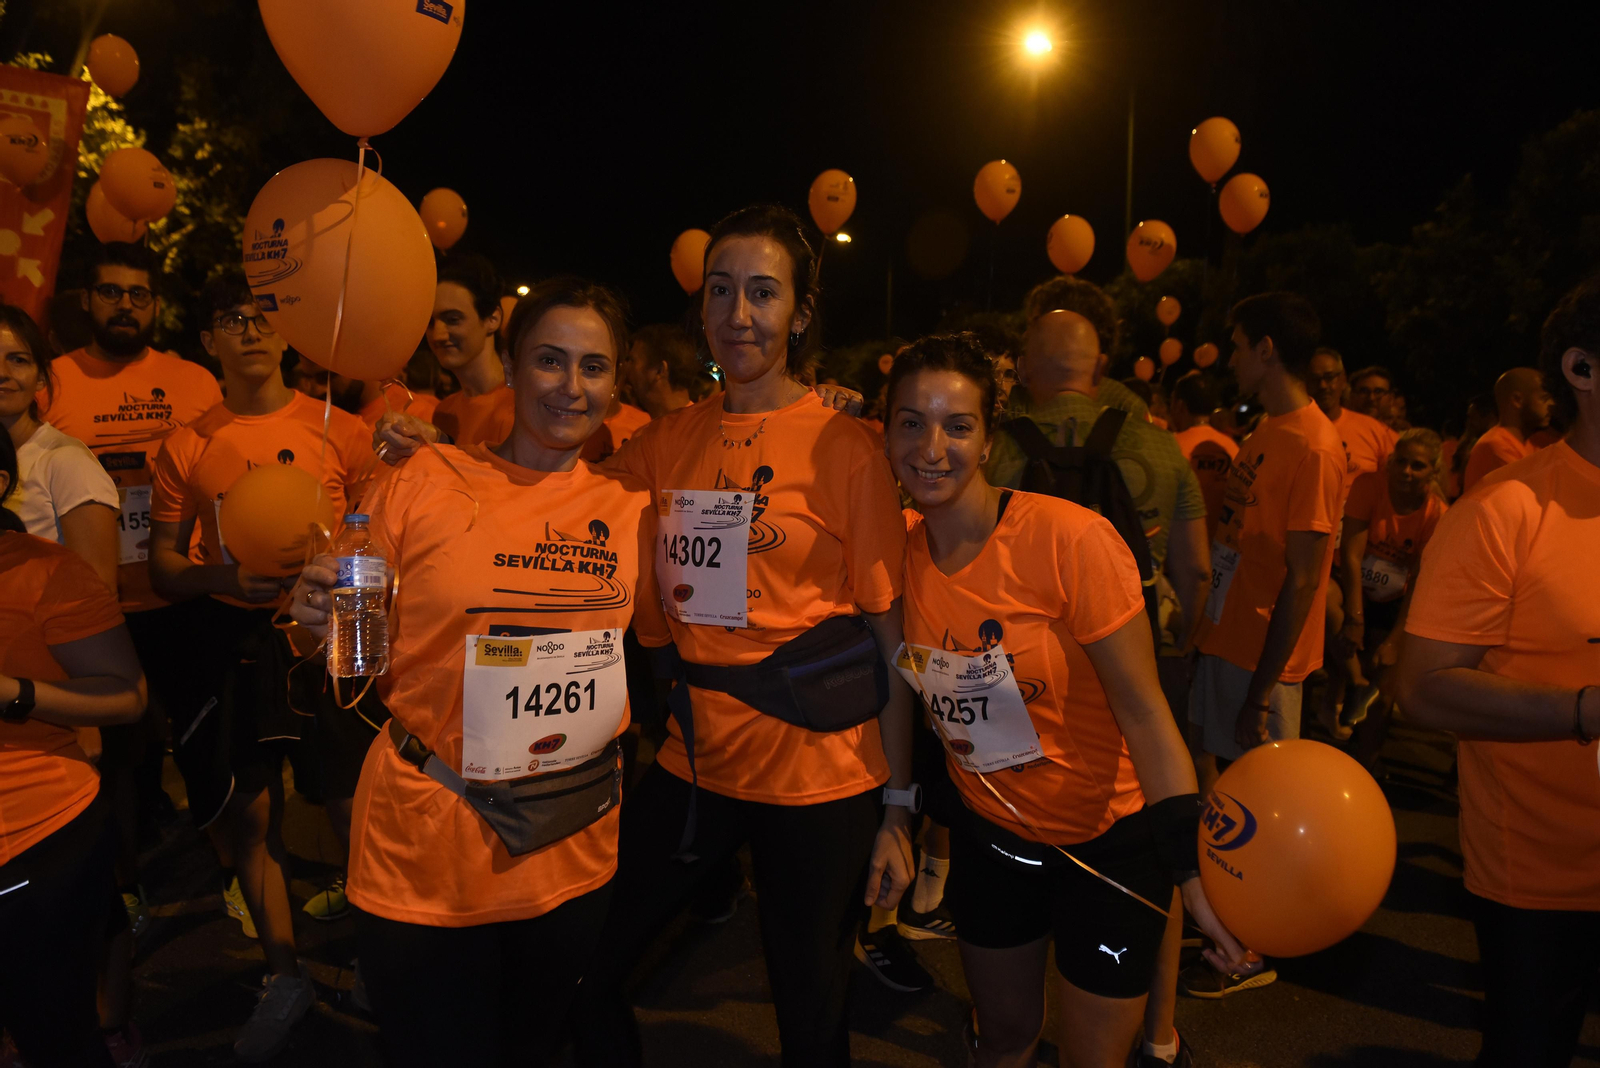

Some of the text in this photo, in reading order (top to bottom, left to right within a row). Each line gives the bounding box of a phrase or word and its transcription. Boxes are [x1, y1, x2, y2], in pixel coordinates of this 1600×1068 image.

[252, 239, 288, 251] NOCTURNA
[118, 403, 173, 413] NOCTURNA
[93, 412, 144, 423] SEVILLA
[535, 542, 618, 564] NOCTURNA
[663, 533, 722, 568] 14302
[493, 553, 575, 573] SEVILLA
[586, 643, 614, 651] NOCTURNA
[574, 650, 600, 658] SEVILLA
[966, 661, 997, 675] NOCTURNA
[956, 672, 982, 680] SEVILLA
[505, 678, 596, 720] 14261
[1206, 848, 1243, 880] SEVILLA
